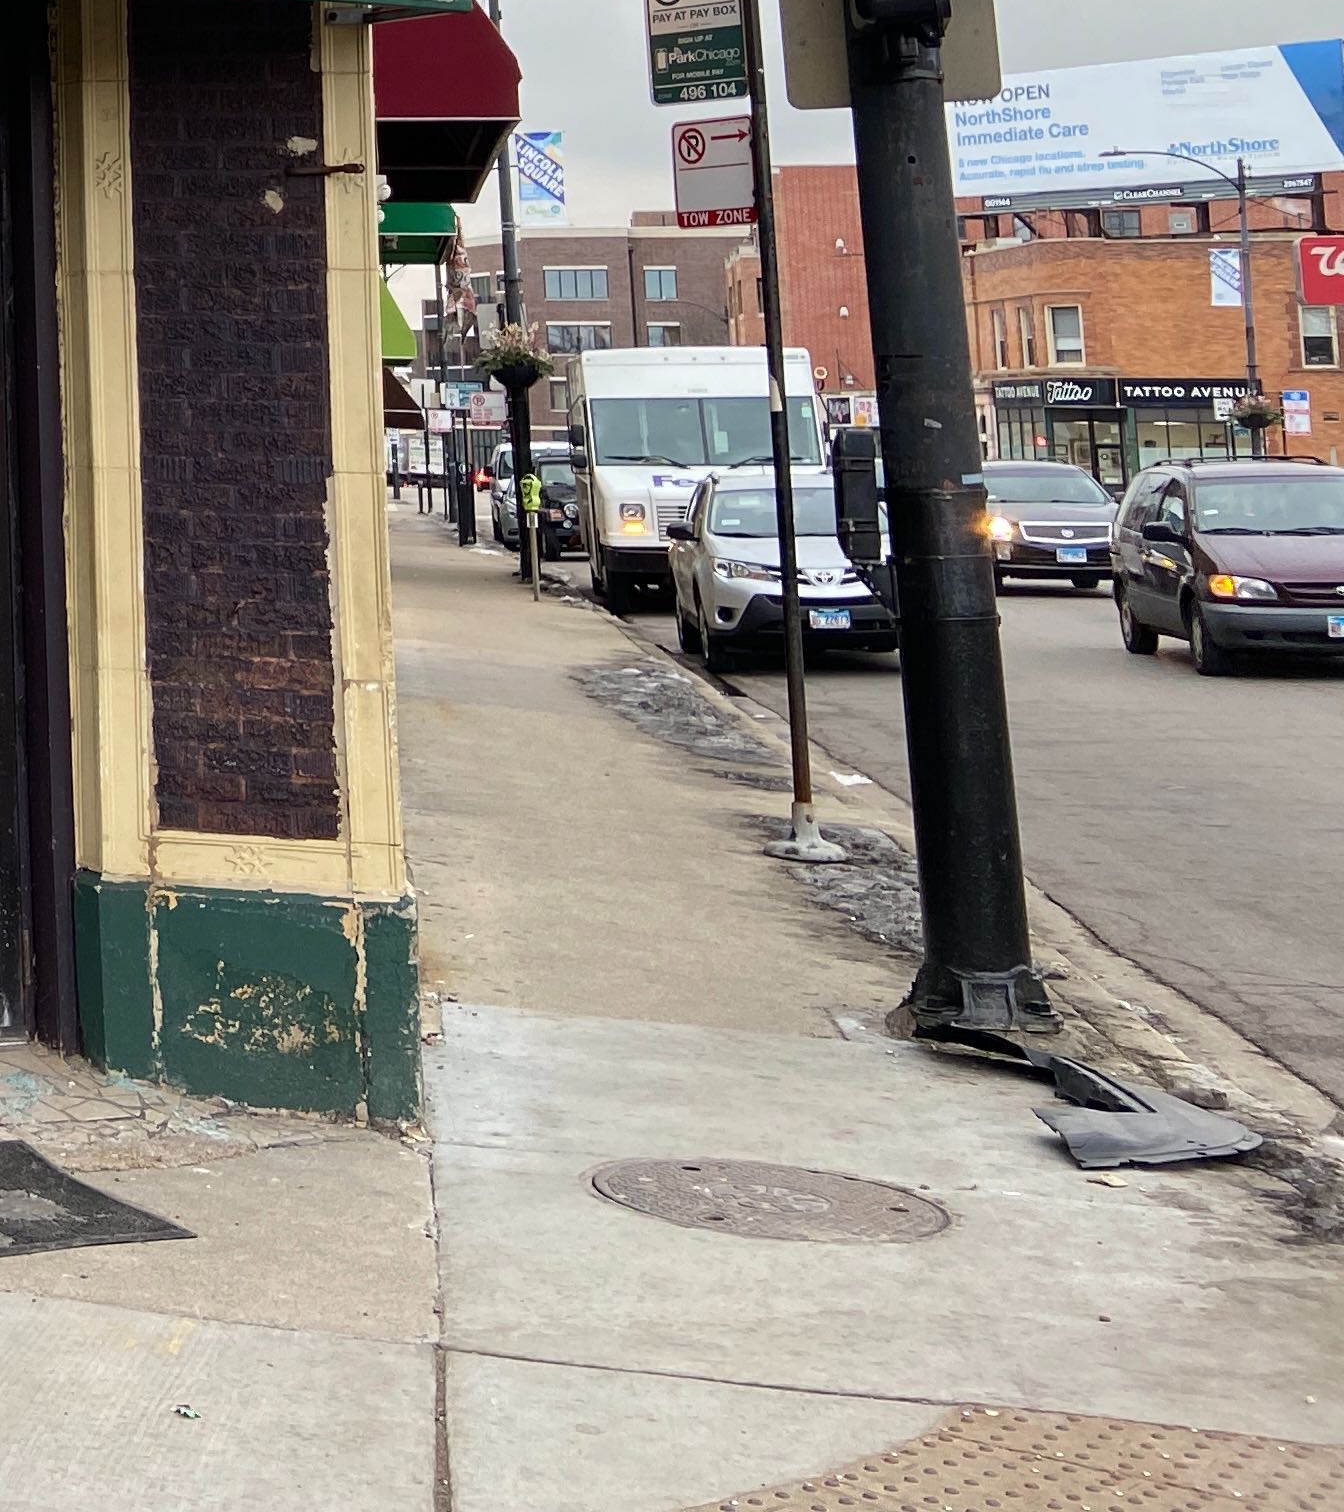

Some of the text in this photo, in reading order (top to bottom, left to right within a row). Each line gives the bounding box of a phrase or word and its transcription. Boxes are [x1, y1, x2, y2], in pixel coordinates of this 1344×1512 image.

[653, 5, 737, 24] PAY AT PAY BOX
[668, 48, 740, 64] ParkChicago
[672, 72, 685, 80] FOR
[680, 82, 737, 101] 496 104
[1001, 83, 1050, 102] OPEN
[955, 106, 1051, 128] NorthShore
[957, 123, 1089, 147] Immediate Care
[1179, 137, 1280, 157] NorthShore
[517, 139, 563, 182] LINCOLN
[1054, 162, 1074, 174] and
[519, 157, 564, 197] SQUARE
[681, 207, 752, 226] TOW ZONE
[1047, 381, 1092, 403] Tattoo
[1124, 386, 1185, 397] TATTOO
